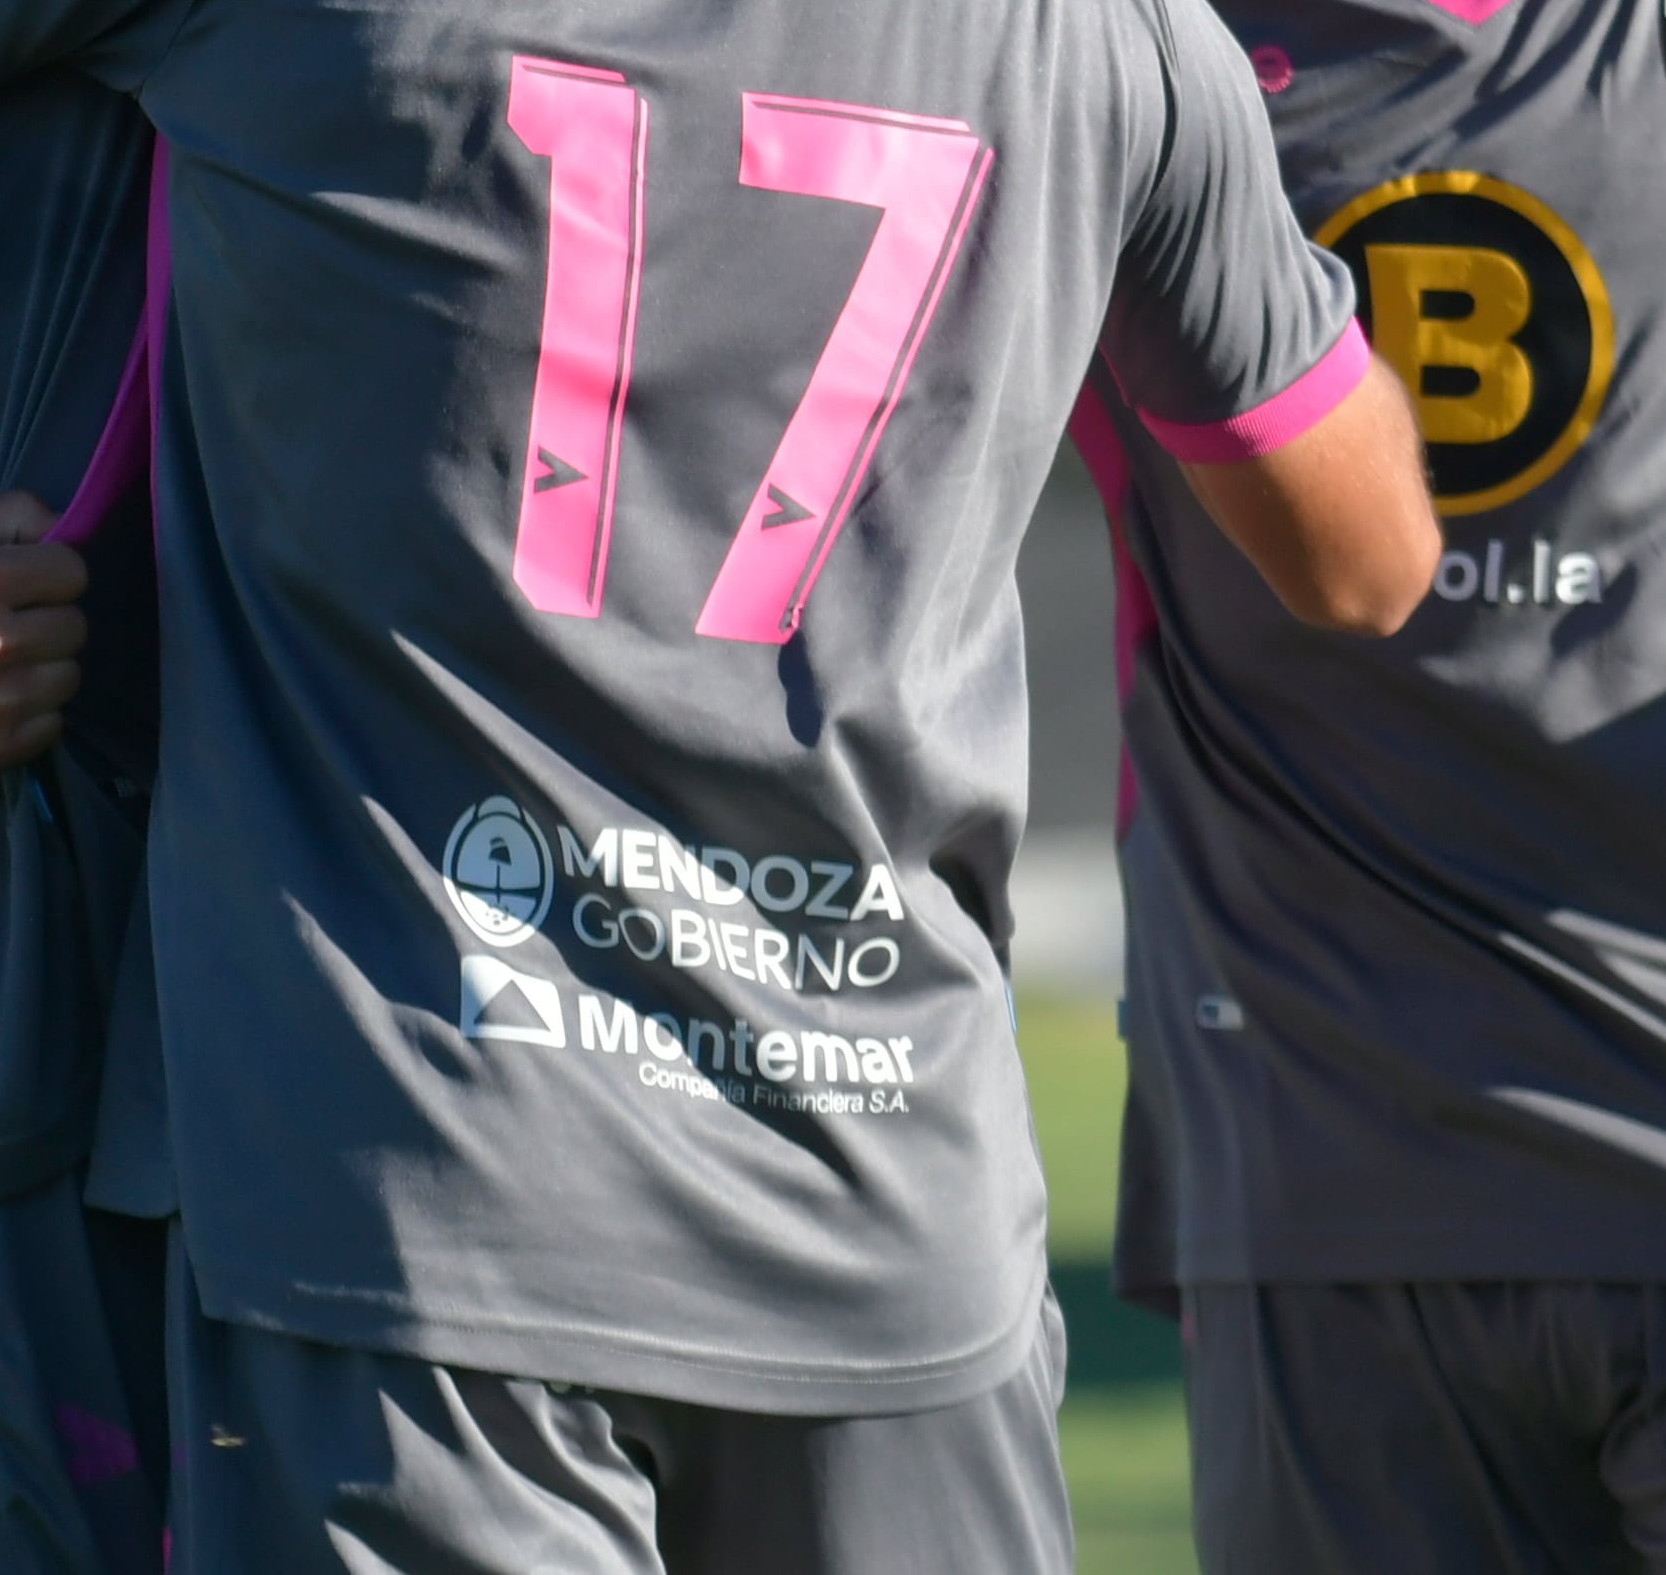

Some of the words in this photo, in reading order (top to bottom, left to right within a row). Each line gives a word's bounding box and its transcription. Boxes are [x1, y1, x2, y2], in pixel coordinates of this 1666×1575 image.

[507, 55, 993, 645] 17
[1364, 243, 1531, 445] B
[1434, 538, 1602, 605] ol.la
[556, 825, 905, 922] MENDOZA
[573, 893, 900, 992] GOBIERNO
[578, 994, 914, 1084] Montemar
[753, 1084, 864, 1114] Financiera
[868, 1089, 910, 1114] S.A.
